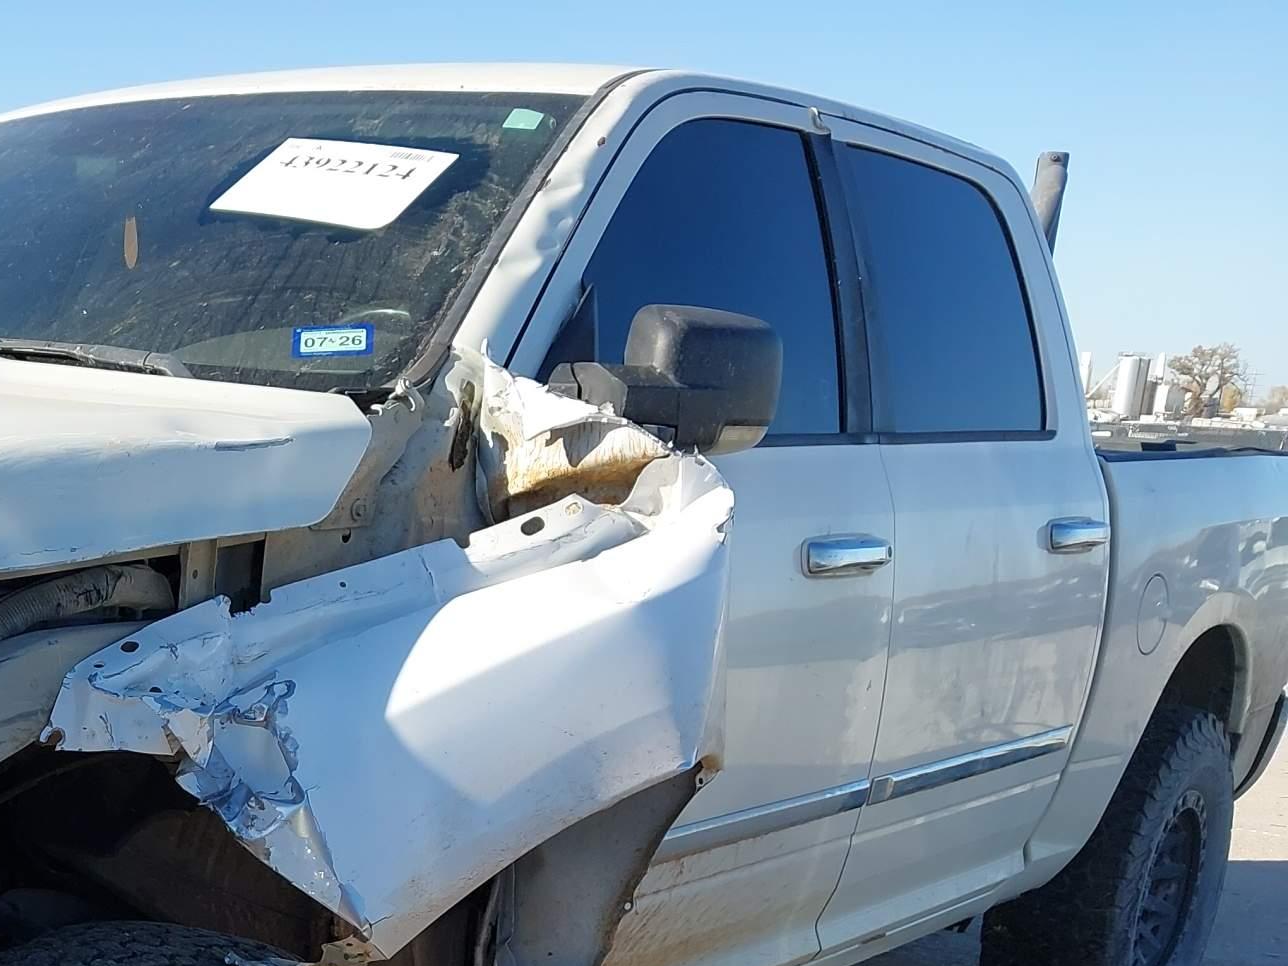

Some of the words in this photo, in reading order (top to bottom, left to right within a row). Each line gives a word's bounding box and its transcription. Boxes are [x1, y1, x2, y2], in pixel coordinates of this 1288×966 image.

[280, 154, 417, 180] 43922124
[304, 336, 329, 348] 07
[338, 335, 363, 347] 26
